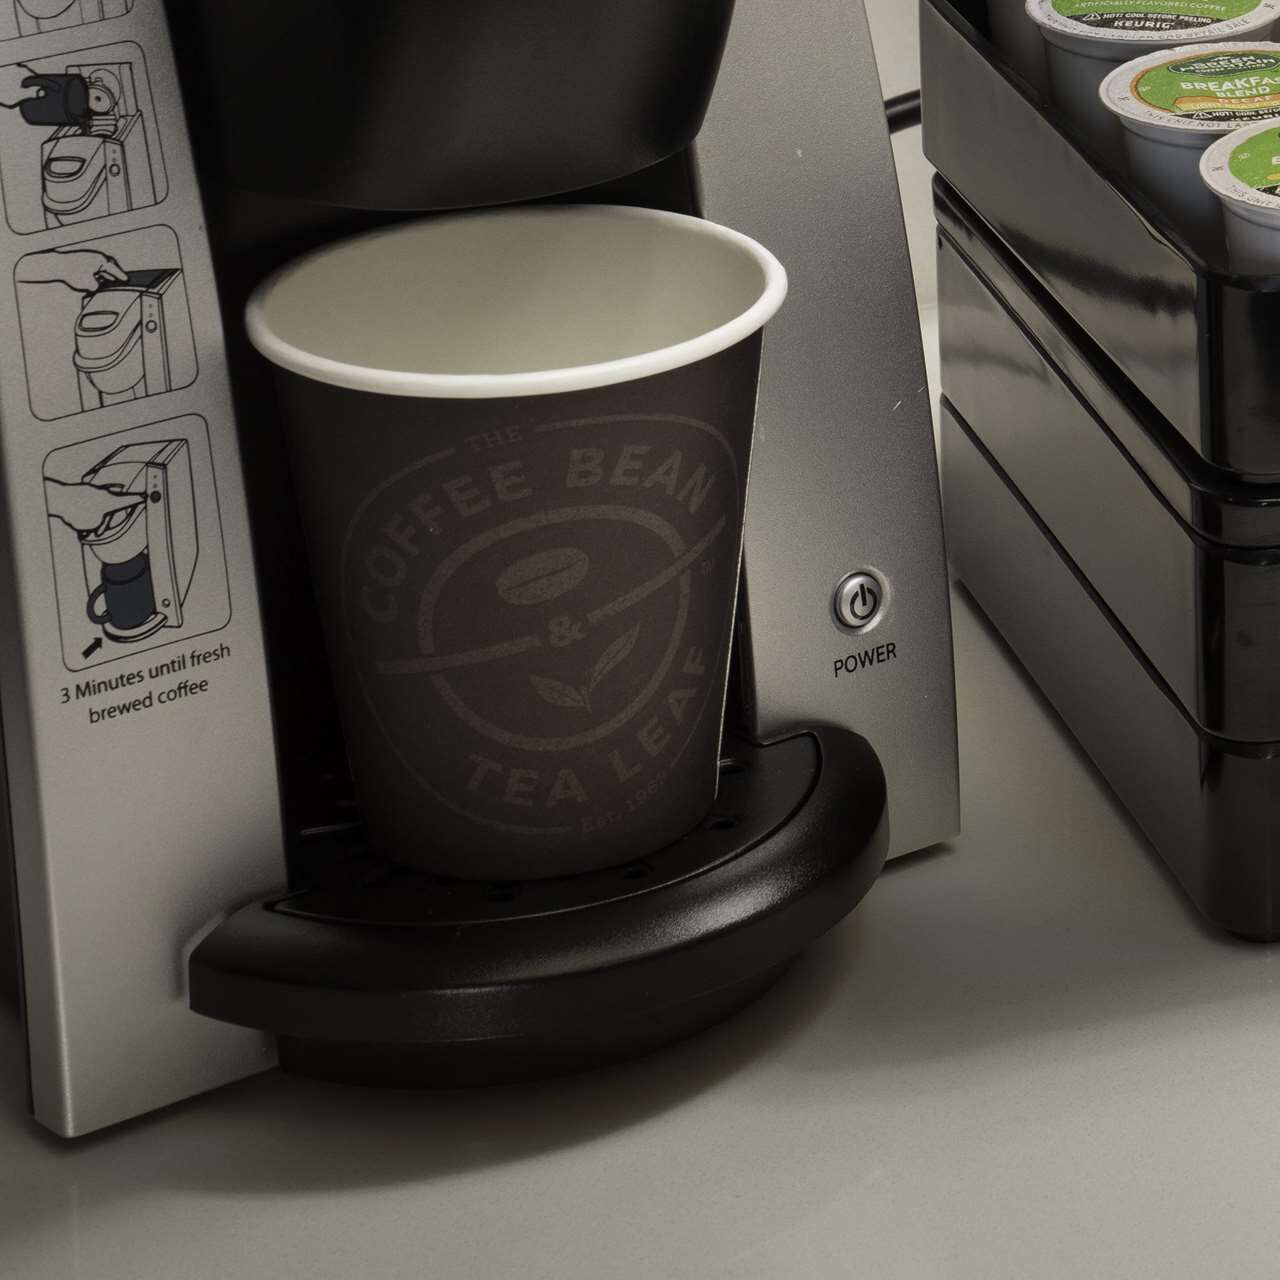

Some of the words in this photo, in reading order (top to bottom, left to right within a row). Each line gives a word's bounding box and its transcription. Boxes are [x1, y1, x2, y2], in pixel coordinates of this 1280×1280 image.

[1113, 20, 1175, 29] KEURIG
[1216, 85, 1271, 98] BLEND
[463, 425, 523, 452] THE
[361, 460, 533, 624] COFFEE
[566, 444, 718, 515] BEAN
[546, 615, 587, 648] &
[60, 688, 71, 704] 3
[75, 670, 145, 700] Minutes
[148, 654, 187, 679] until
[189, 643, 231, 668] fresh
[833, 642, 897, 678] POWER
[88, 691, 153, 724] brewed
[157, 679, 209, 704] coffee
[463, 753, 590, 809] TEA
[608, 645, 706, 783] LEAF
